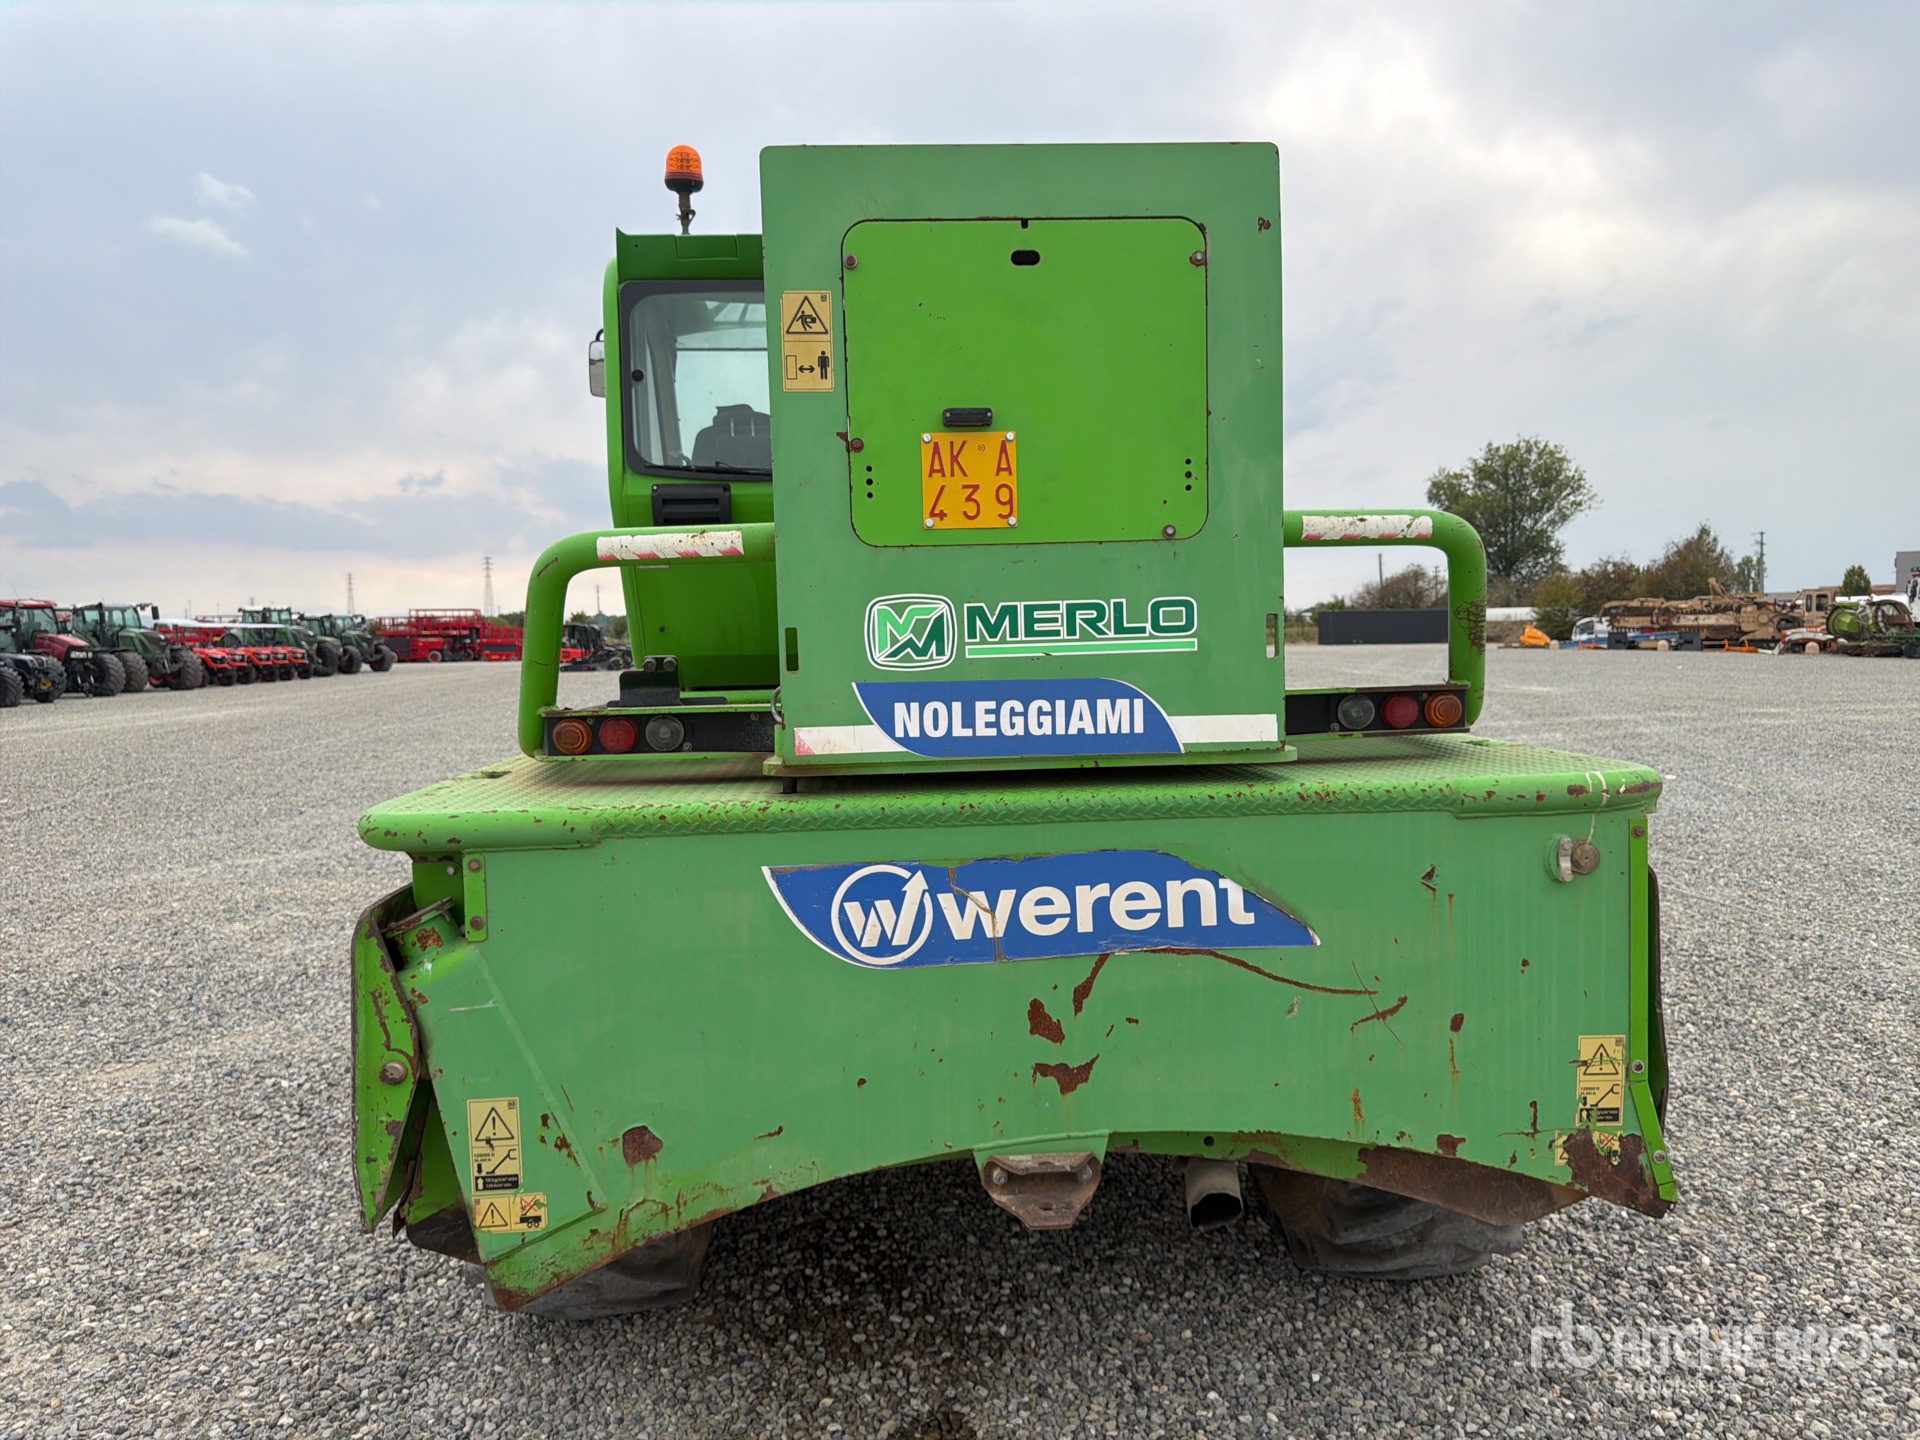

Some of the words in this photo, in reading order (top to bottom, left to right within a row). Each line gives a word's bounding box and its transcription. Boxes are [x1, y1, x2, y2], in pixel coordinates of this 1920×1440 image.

[928, 440, 968, 478] AK
[964, 596, 1199, 642] MERLO
[893, 698, 1145, 738] NOLEGGIAMI
[936, 875, 1256, 940] werent
